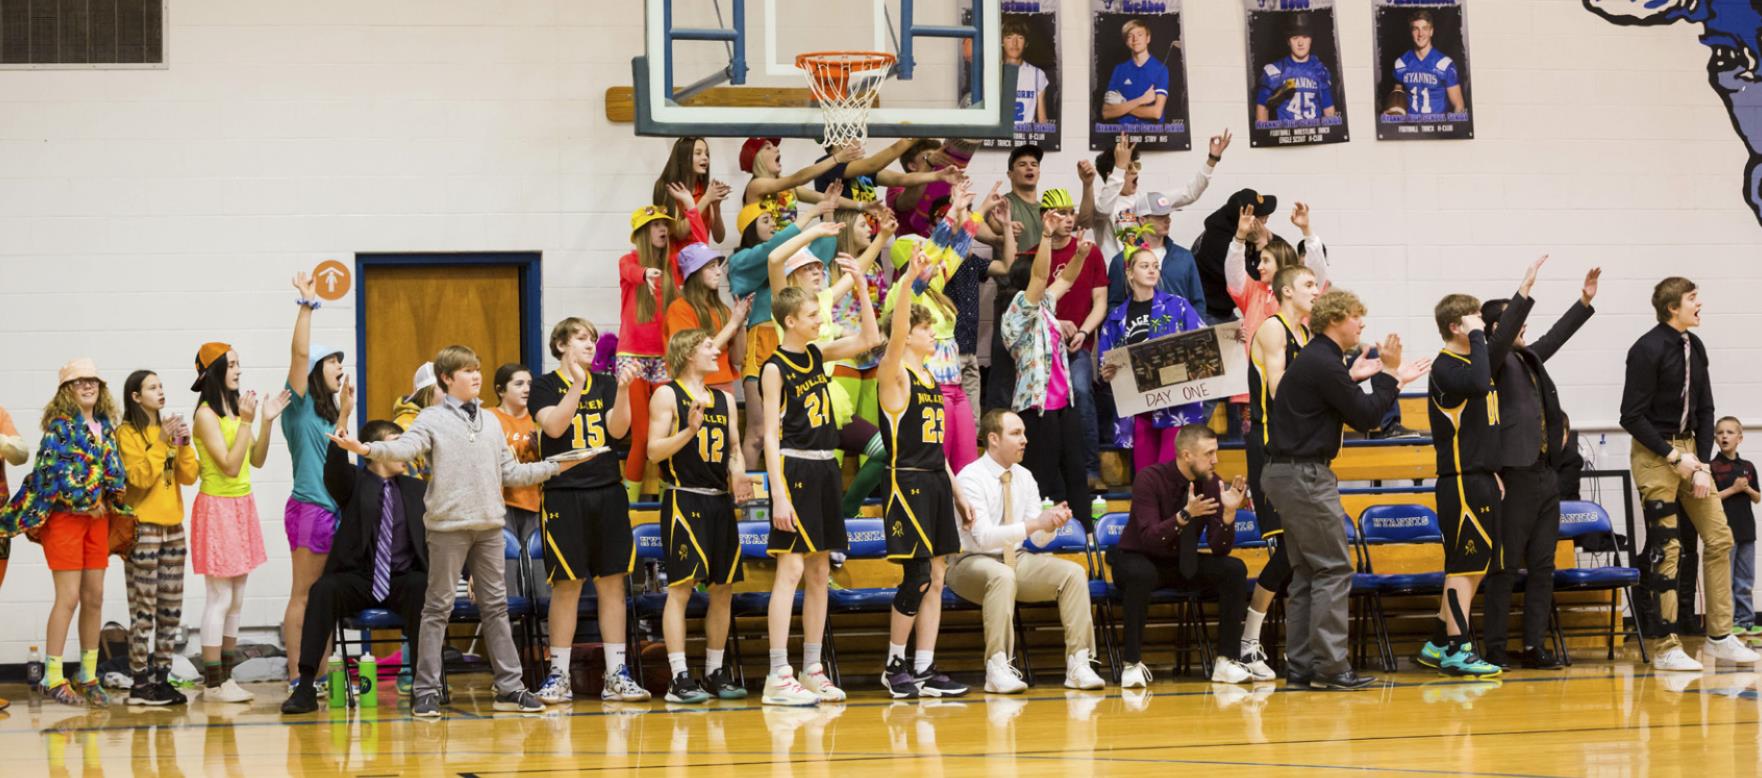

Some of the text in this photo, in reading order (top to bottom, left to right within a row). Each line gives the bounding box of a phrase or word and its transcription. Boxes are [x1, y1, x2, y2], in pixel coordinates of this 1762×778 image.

[1286, 91, 1316, 120] 45
[1410, 86, 1432, 114] 11
[1145, 382, 1210, 408] DAY ONE
[571, 412, 606, 449] 15
[921, 406, 945, 444] 23
[696, 426, 725, 463] 12
